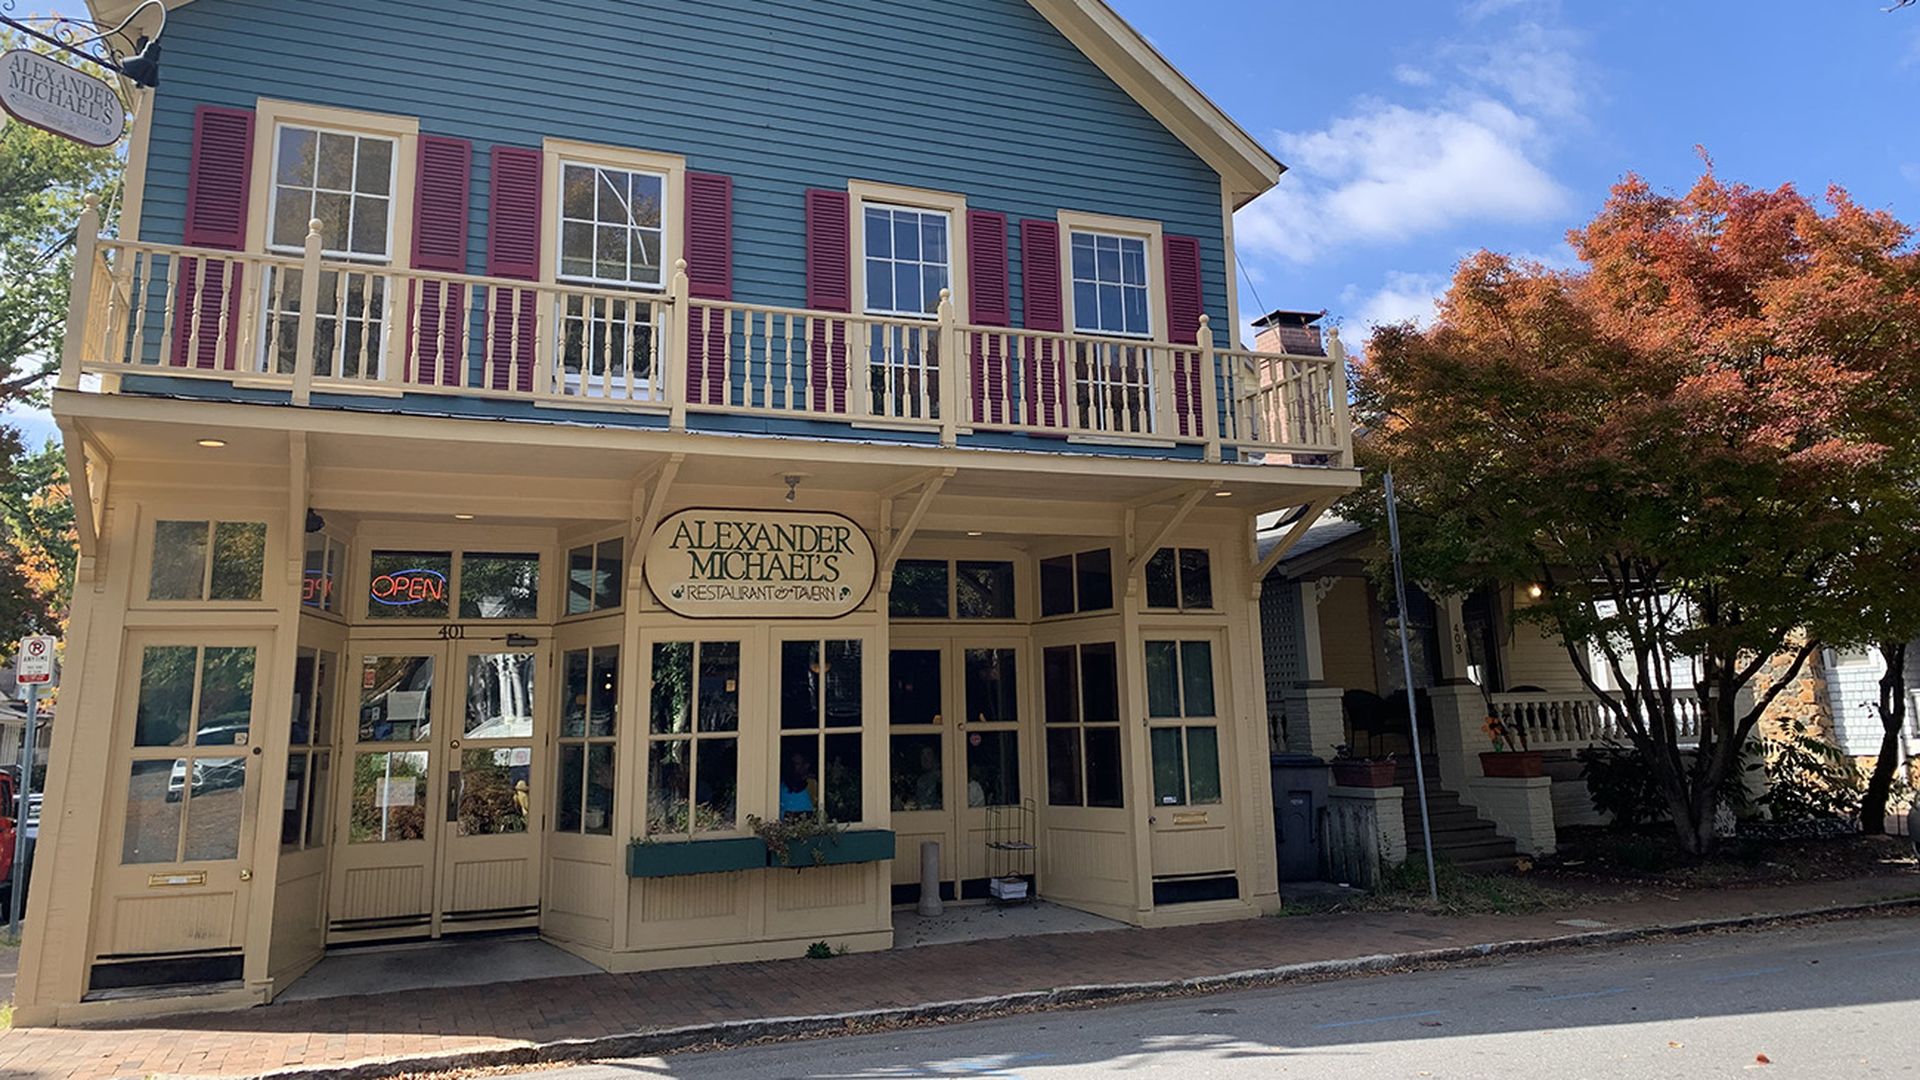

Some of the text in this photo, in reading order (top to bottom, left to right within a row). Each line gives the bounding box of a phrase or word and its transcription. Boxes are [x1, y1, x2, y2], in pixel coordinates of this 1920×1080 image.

[8, 54, 115, 110] ALEXANDER
[9, 71, 113, 125] MICHAEL'S
[669, 520, 854, 555] ALEXANDER
[687, 551, 840, 582] MICHAEL'S
[372, 575, 443, 600] OPEN
[687, 585, 775, 600] RESTAURANT
[791, 585, 836, 601] TAVERN
[438, 624, 465, 640] 401
[1453, 623, 1463, 655] 403
